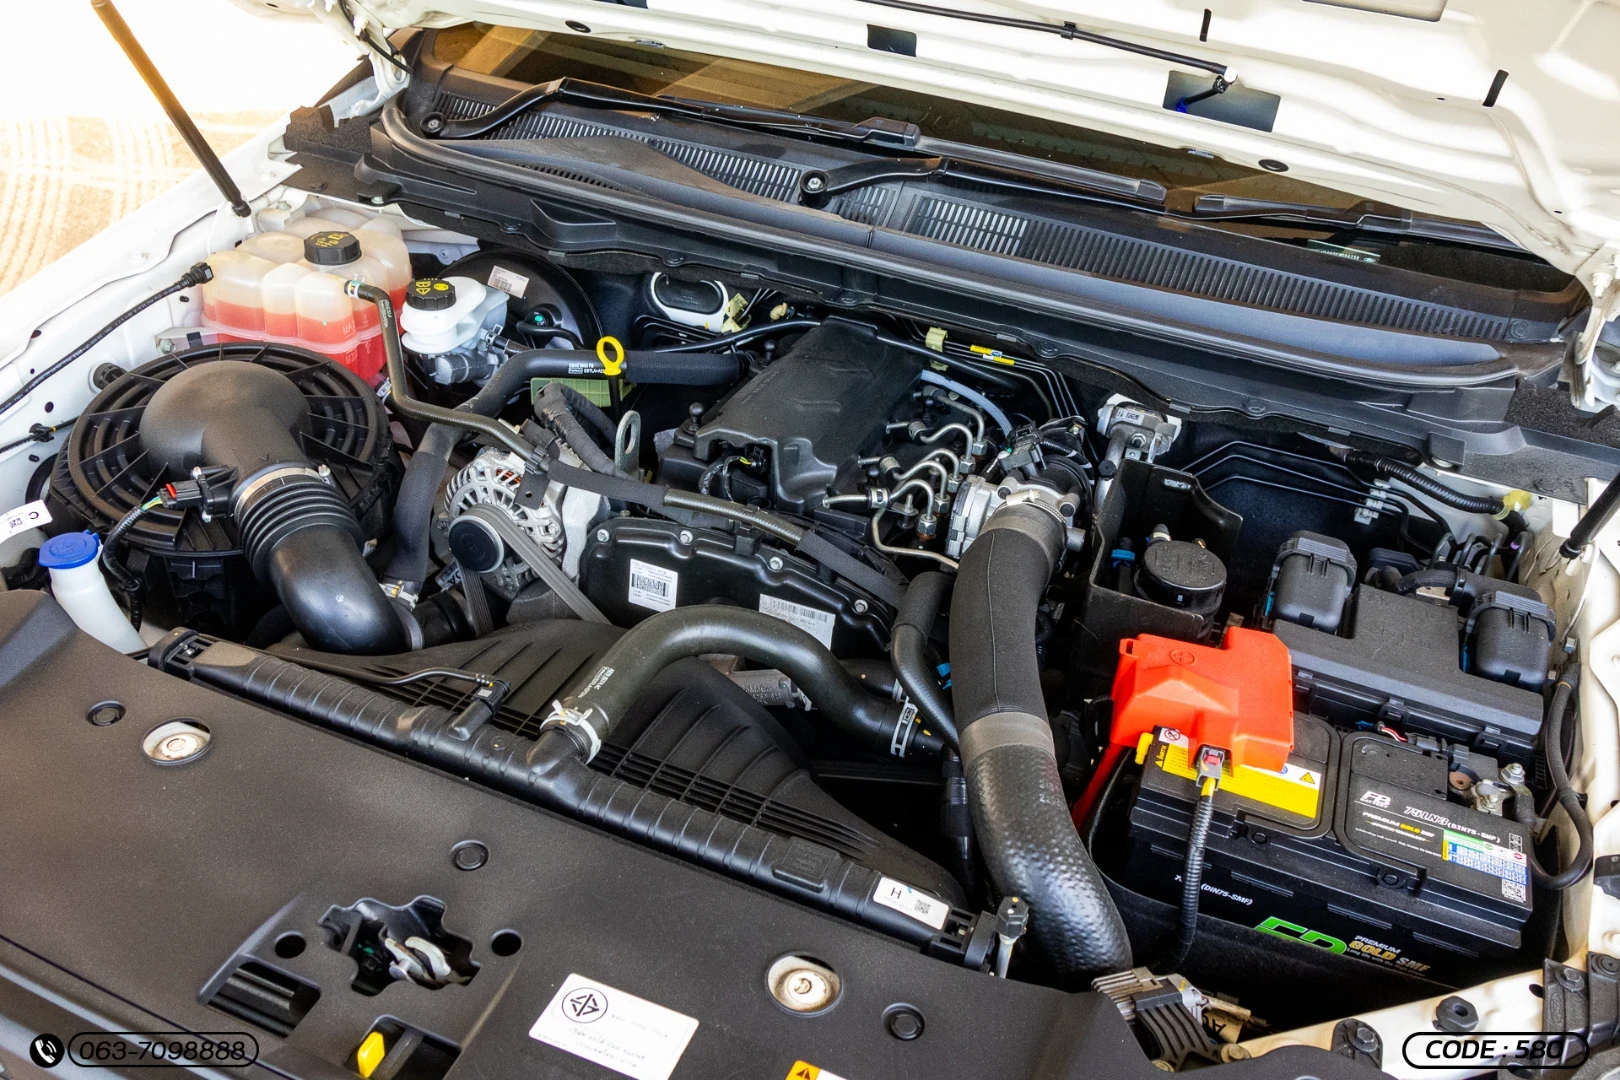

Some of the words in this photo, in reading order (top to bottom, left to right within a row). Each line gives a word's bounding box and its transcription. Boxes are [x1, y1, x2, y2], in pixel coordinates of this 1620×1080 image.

[1359, 790, 1391, 804] FB
[1362, 811, 1400, 827] PREMIUM
[1399, 821, 1421, 834] GOLD
[890, 887, 902, 899] H
[1200, 883, 1253, 906] (DIN75-SMF)
[1354, 935, 1401, 954] PREMIUM
[1348, 940, 1397, 960] GOLD
[1397, 957, 1431, 972] SMF
